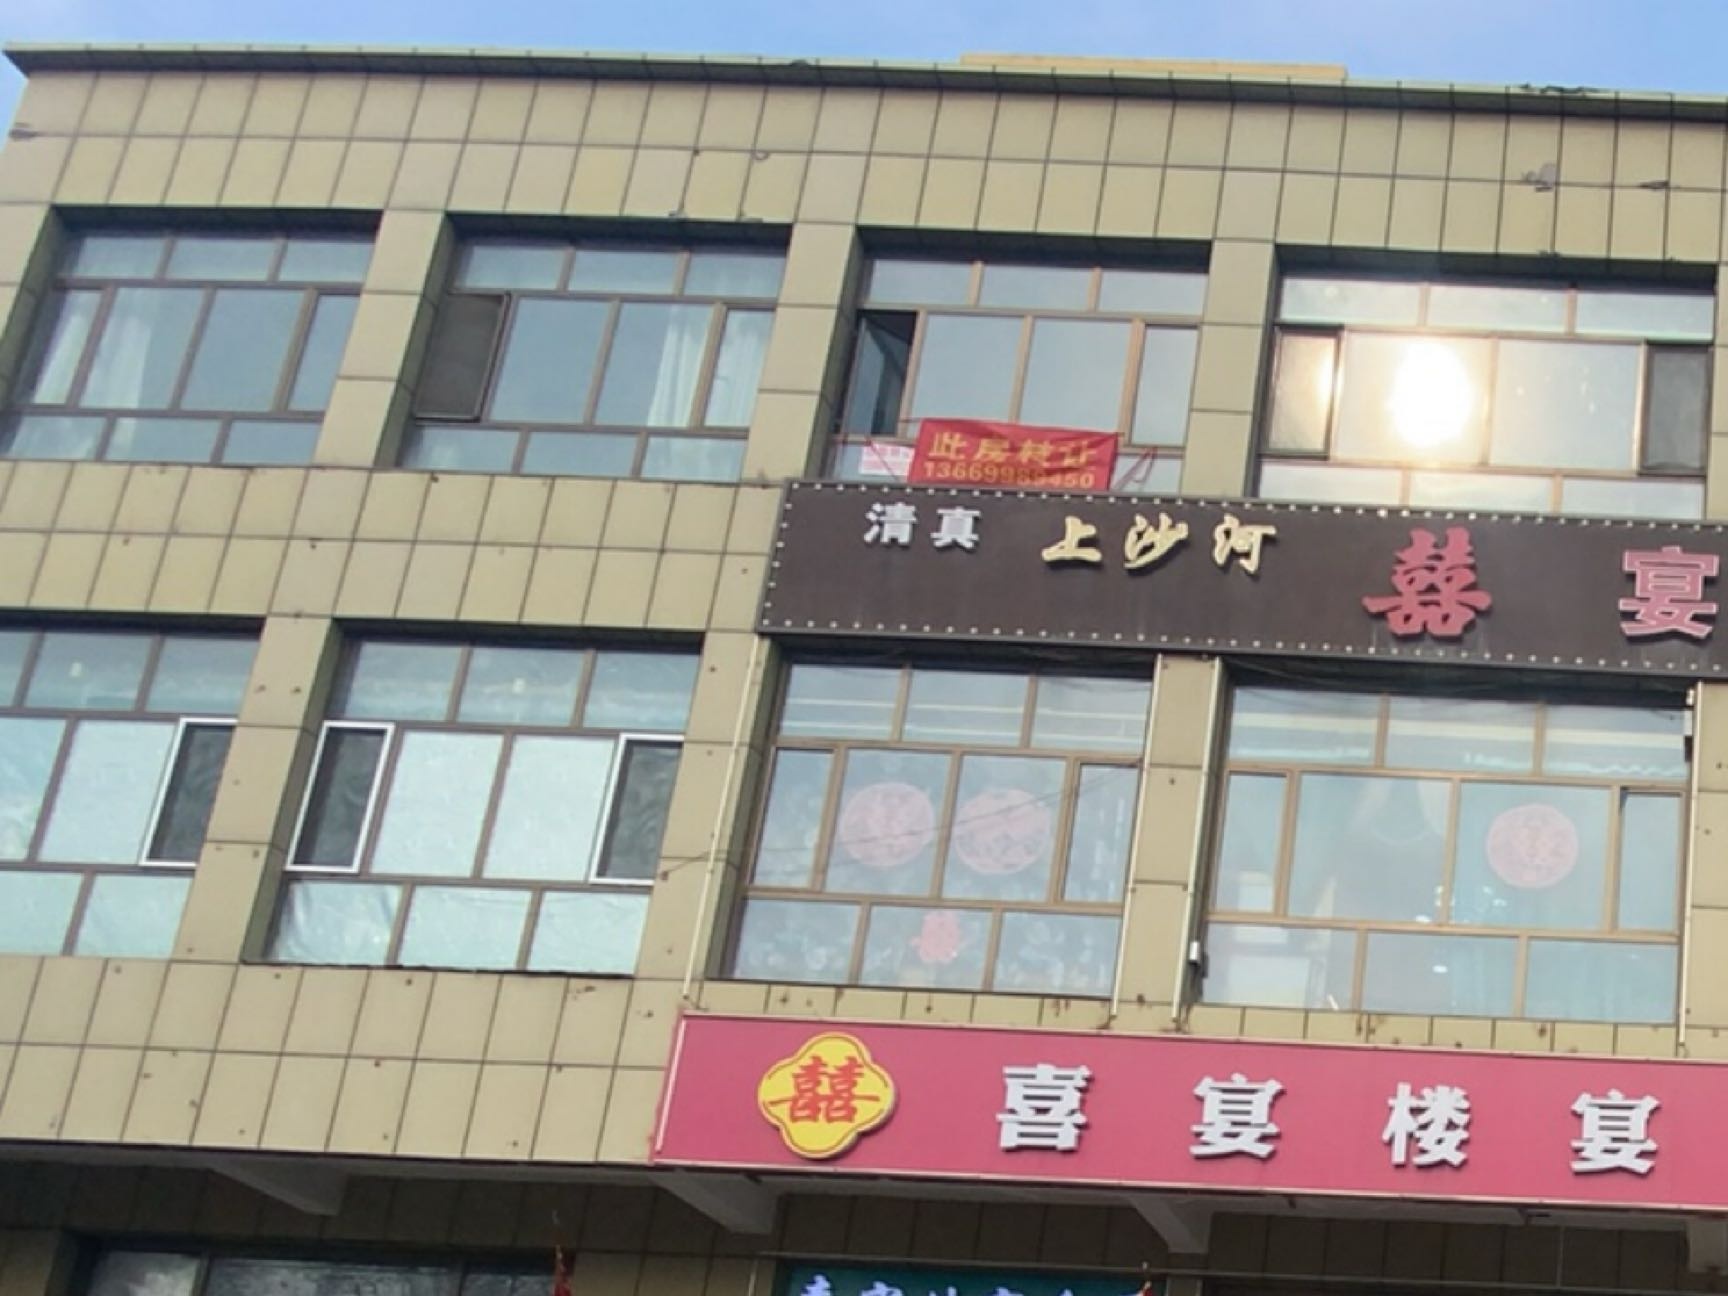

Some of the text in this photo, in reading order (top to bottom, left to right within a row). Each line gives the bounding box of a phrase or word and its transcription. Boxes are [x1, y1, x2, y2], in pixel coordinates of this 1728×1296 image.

[864, 502, 982, 549] 清真
[1041, 513, 1277, 575] 上沙河
